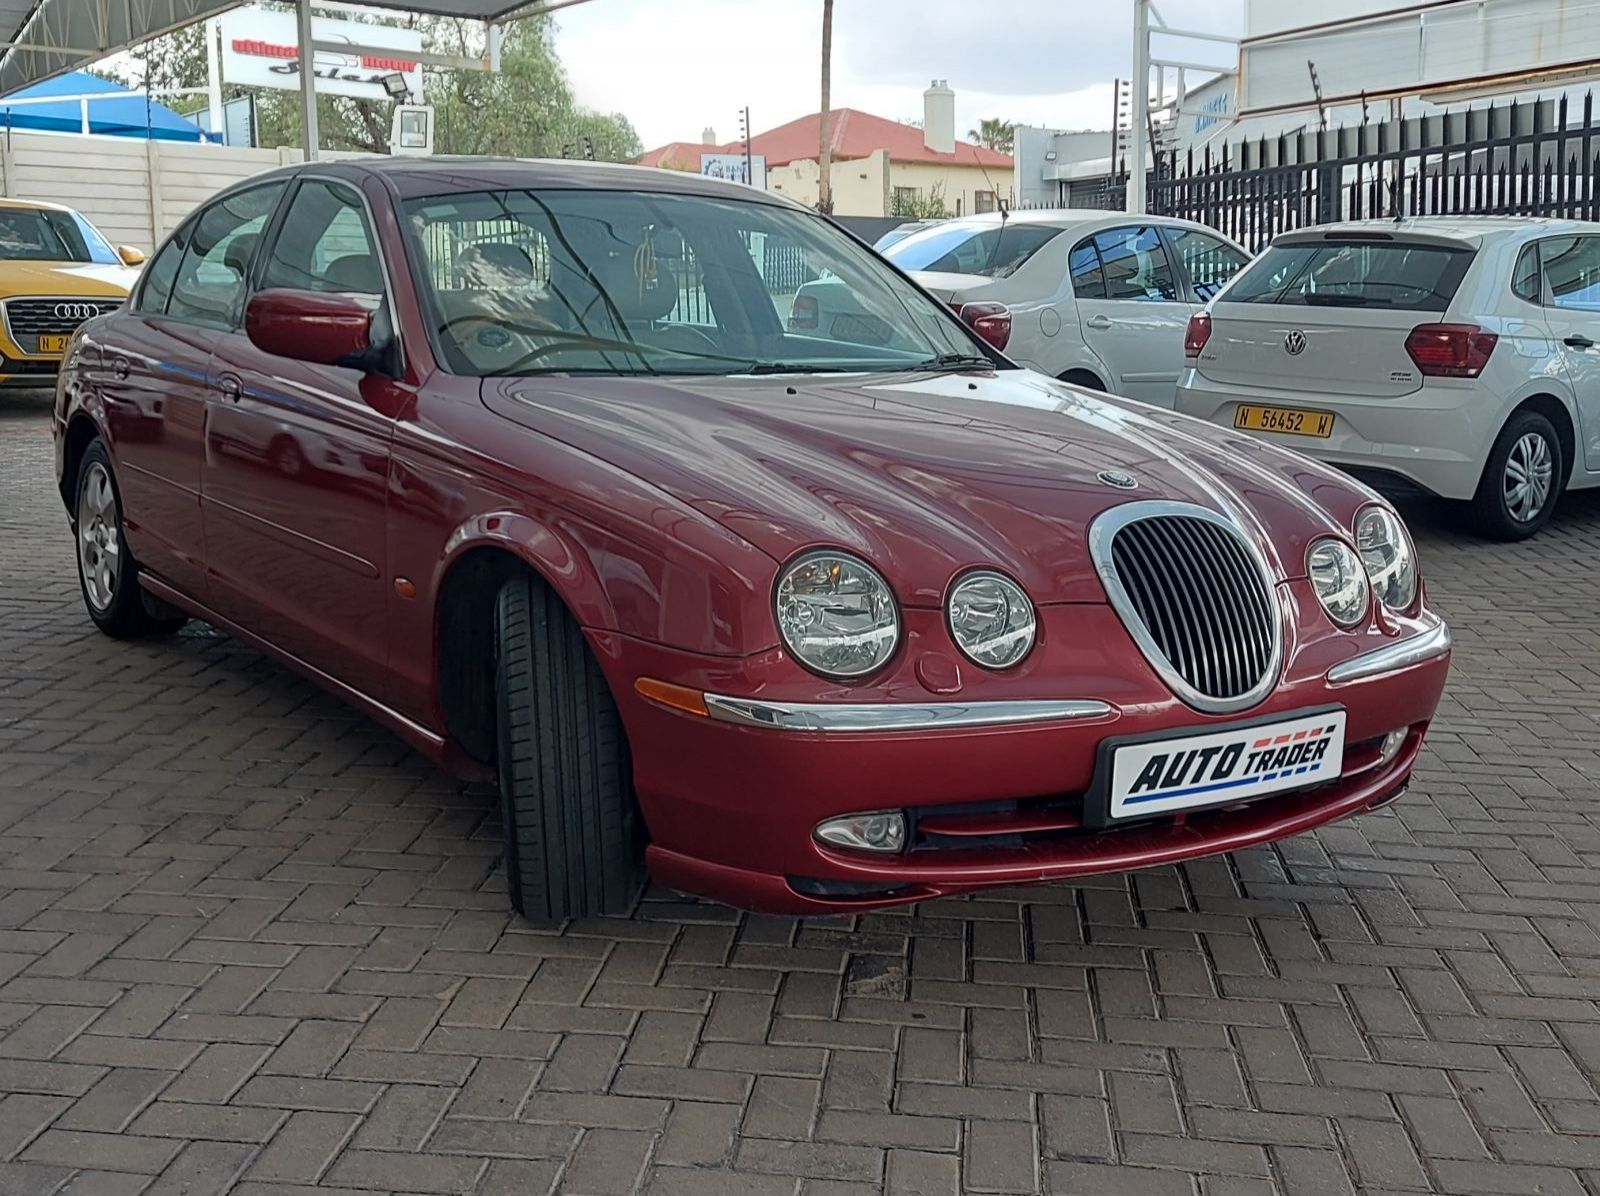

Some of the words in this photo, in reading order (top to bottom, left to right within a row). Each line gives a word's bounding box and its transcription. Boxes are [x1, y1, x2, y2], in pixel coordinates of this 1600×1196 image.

[42, 337, 49, 350] N
[1239, 408, 1250, 426] N
[1261, 411, 1304, 431] 56452
[1317, 417, 1328, 435] W
[1128, 742, 1246, 795] AUTO
[1243, 737, 1331, 776] TRADER
